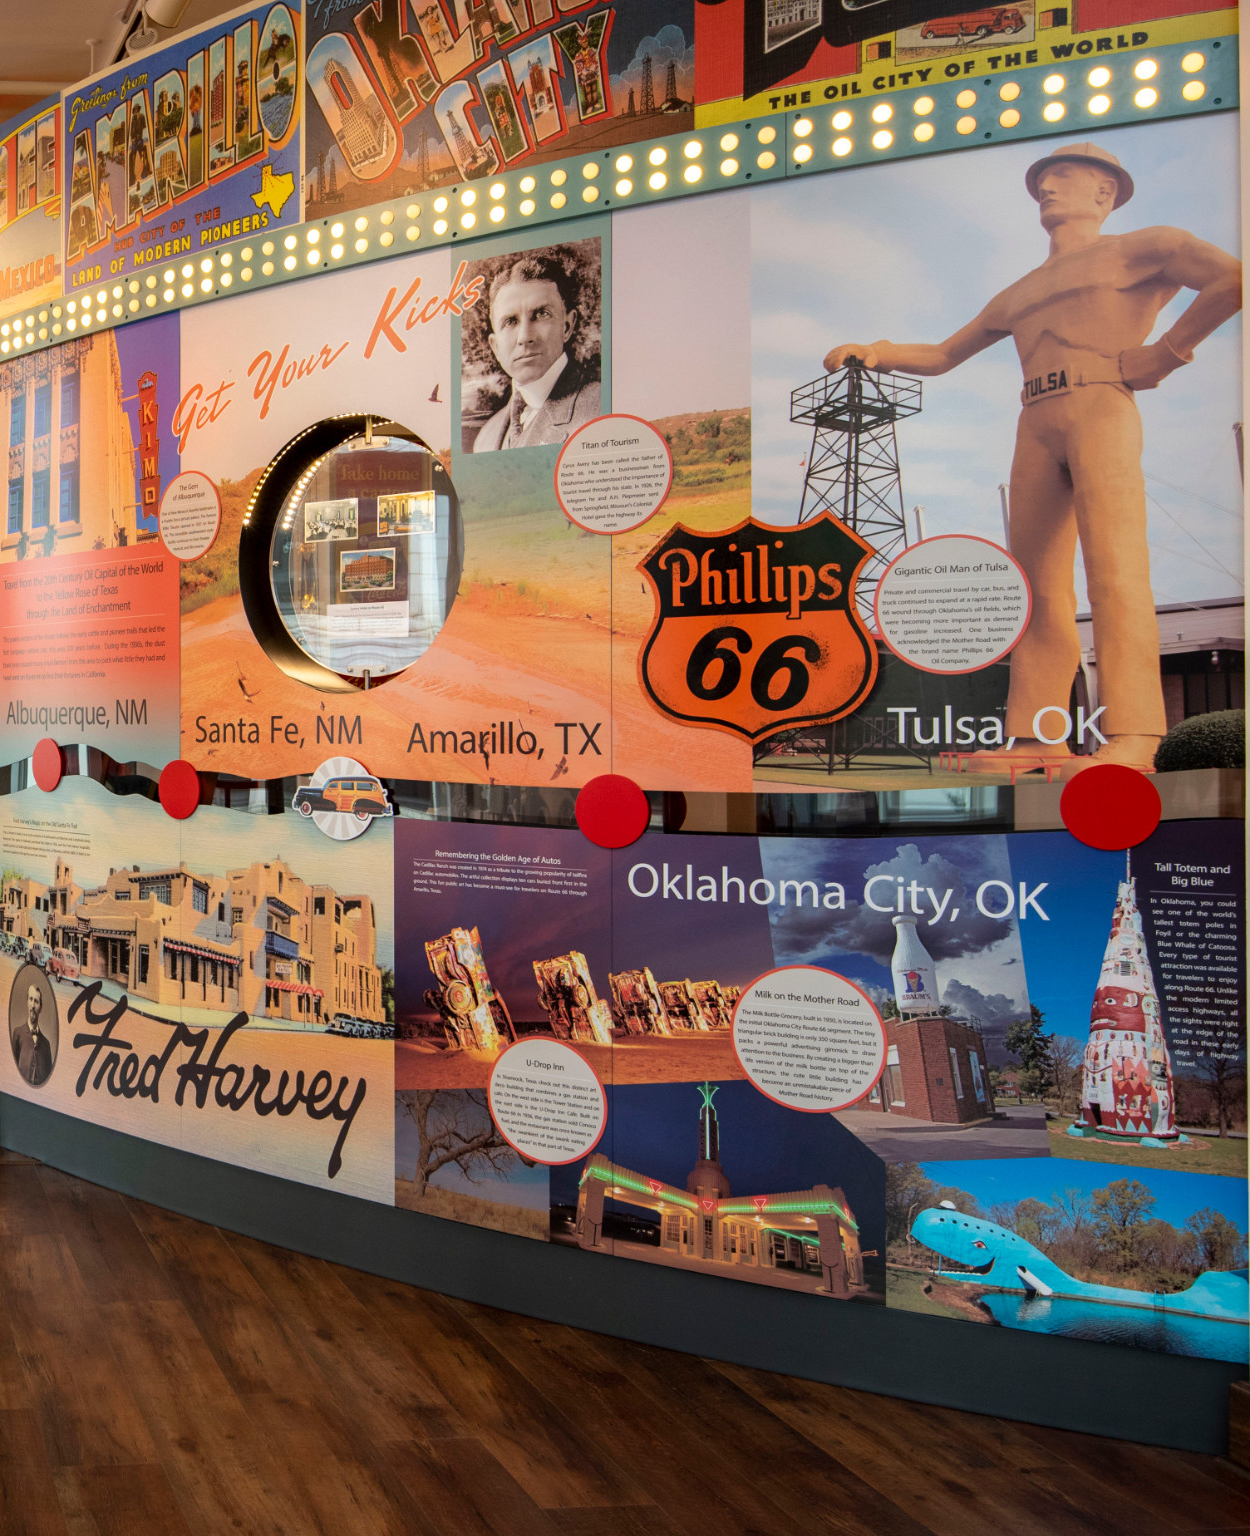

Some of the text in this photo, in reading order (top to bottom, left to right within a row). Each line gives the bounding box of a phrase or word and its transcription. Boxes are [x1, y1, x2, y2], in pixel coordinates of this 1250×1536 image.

[768, 31, 1150, 110] THE OIL CITY OF THE WORLD
[69, 72, 148, 132] Greetings from
[434, 8, 615, 182] CITY
[67, 2, 299, 266] AMARILLO
[17, 110, 57, 216] FE
[114, 206, 221, 253] HUB CITY OF THE
[72, 212, 269, 287] LAND OF MODERN PIONEERS
[0, 254, 55, 301] MEXICO
[171, 260, 486, 456] Get Your Kicks
[1024, 369, 1068, 400] TULSA
[141, 401, 157, 506] KIMO
[581, 438, 639, 450] Titan of Tourism
[379, 463, 419, 480] home
[58, 572, 83, 585] Century
[84, 570, 93, 580] Oil
[94, 567, 118, 581] Capital
[118, 565, 127, 576] of
[128, 564, 140, 575] the
[140, 561, 164, 573] World
[658, 541, 843, 620] Phillips
[894, 562, 1009, 578] Gigantic Oil Man of Tulsa
[61, 605, 78, 616] Land
[78, 603, 86, 614] of
[86, 601, 131, 613] Enchantment
[75, 586, 91, 597] Rose
[91, 585, 100, 596] of
[100, 584, 119, 595] Texas
[686, 626, 821, 711] 66
[6, 699, 148, 731] Albuquerque, NM
[195, 715, 363, 748] Santa Fe, NM
[886, 704, 1109, 751] Tulsa, OK
[407, 722, 603, 760] Amarillo, TX
[435, 850, 562, 865] Remembering the Golden Age of Autos
[1154, 862, 1231, 874] Tall Totem and
[627, 862, 1050, 924] Oklahoma City, OK
[1171, 875, 1214, 888] Big Blue
[1161, 897, 1197, 906] Oklahoma,
[754, 990, 860, 1007] Milk on the Mother Road
[67, 979, 367, 1179] Fred Harvey
[526, 1059, 565, 1072] U-Drop Inn
